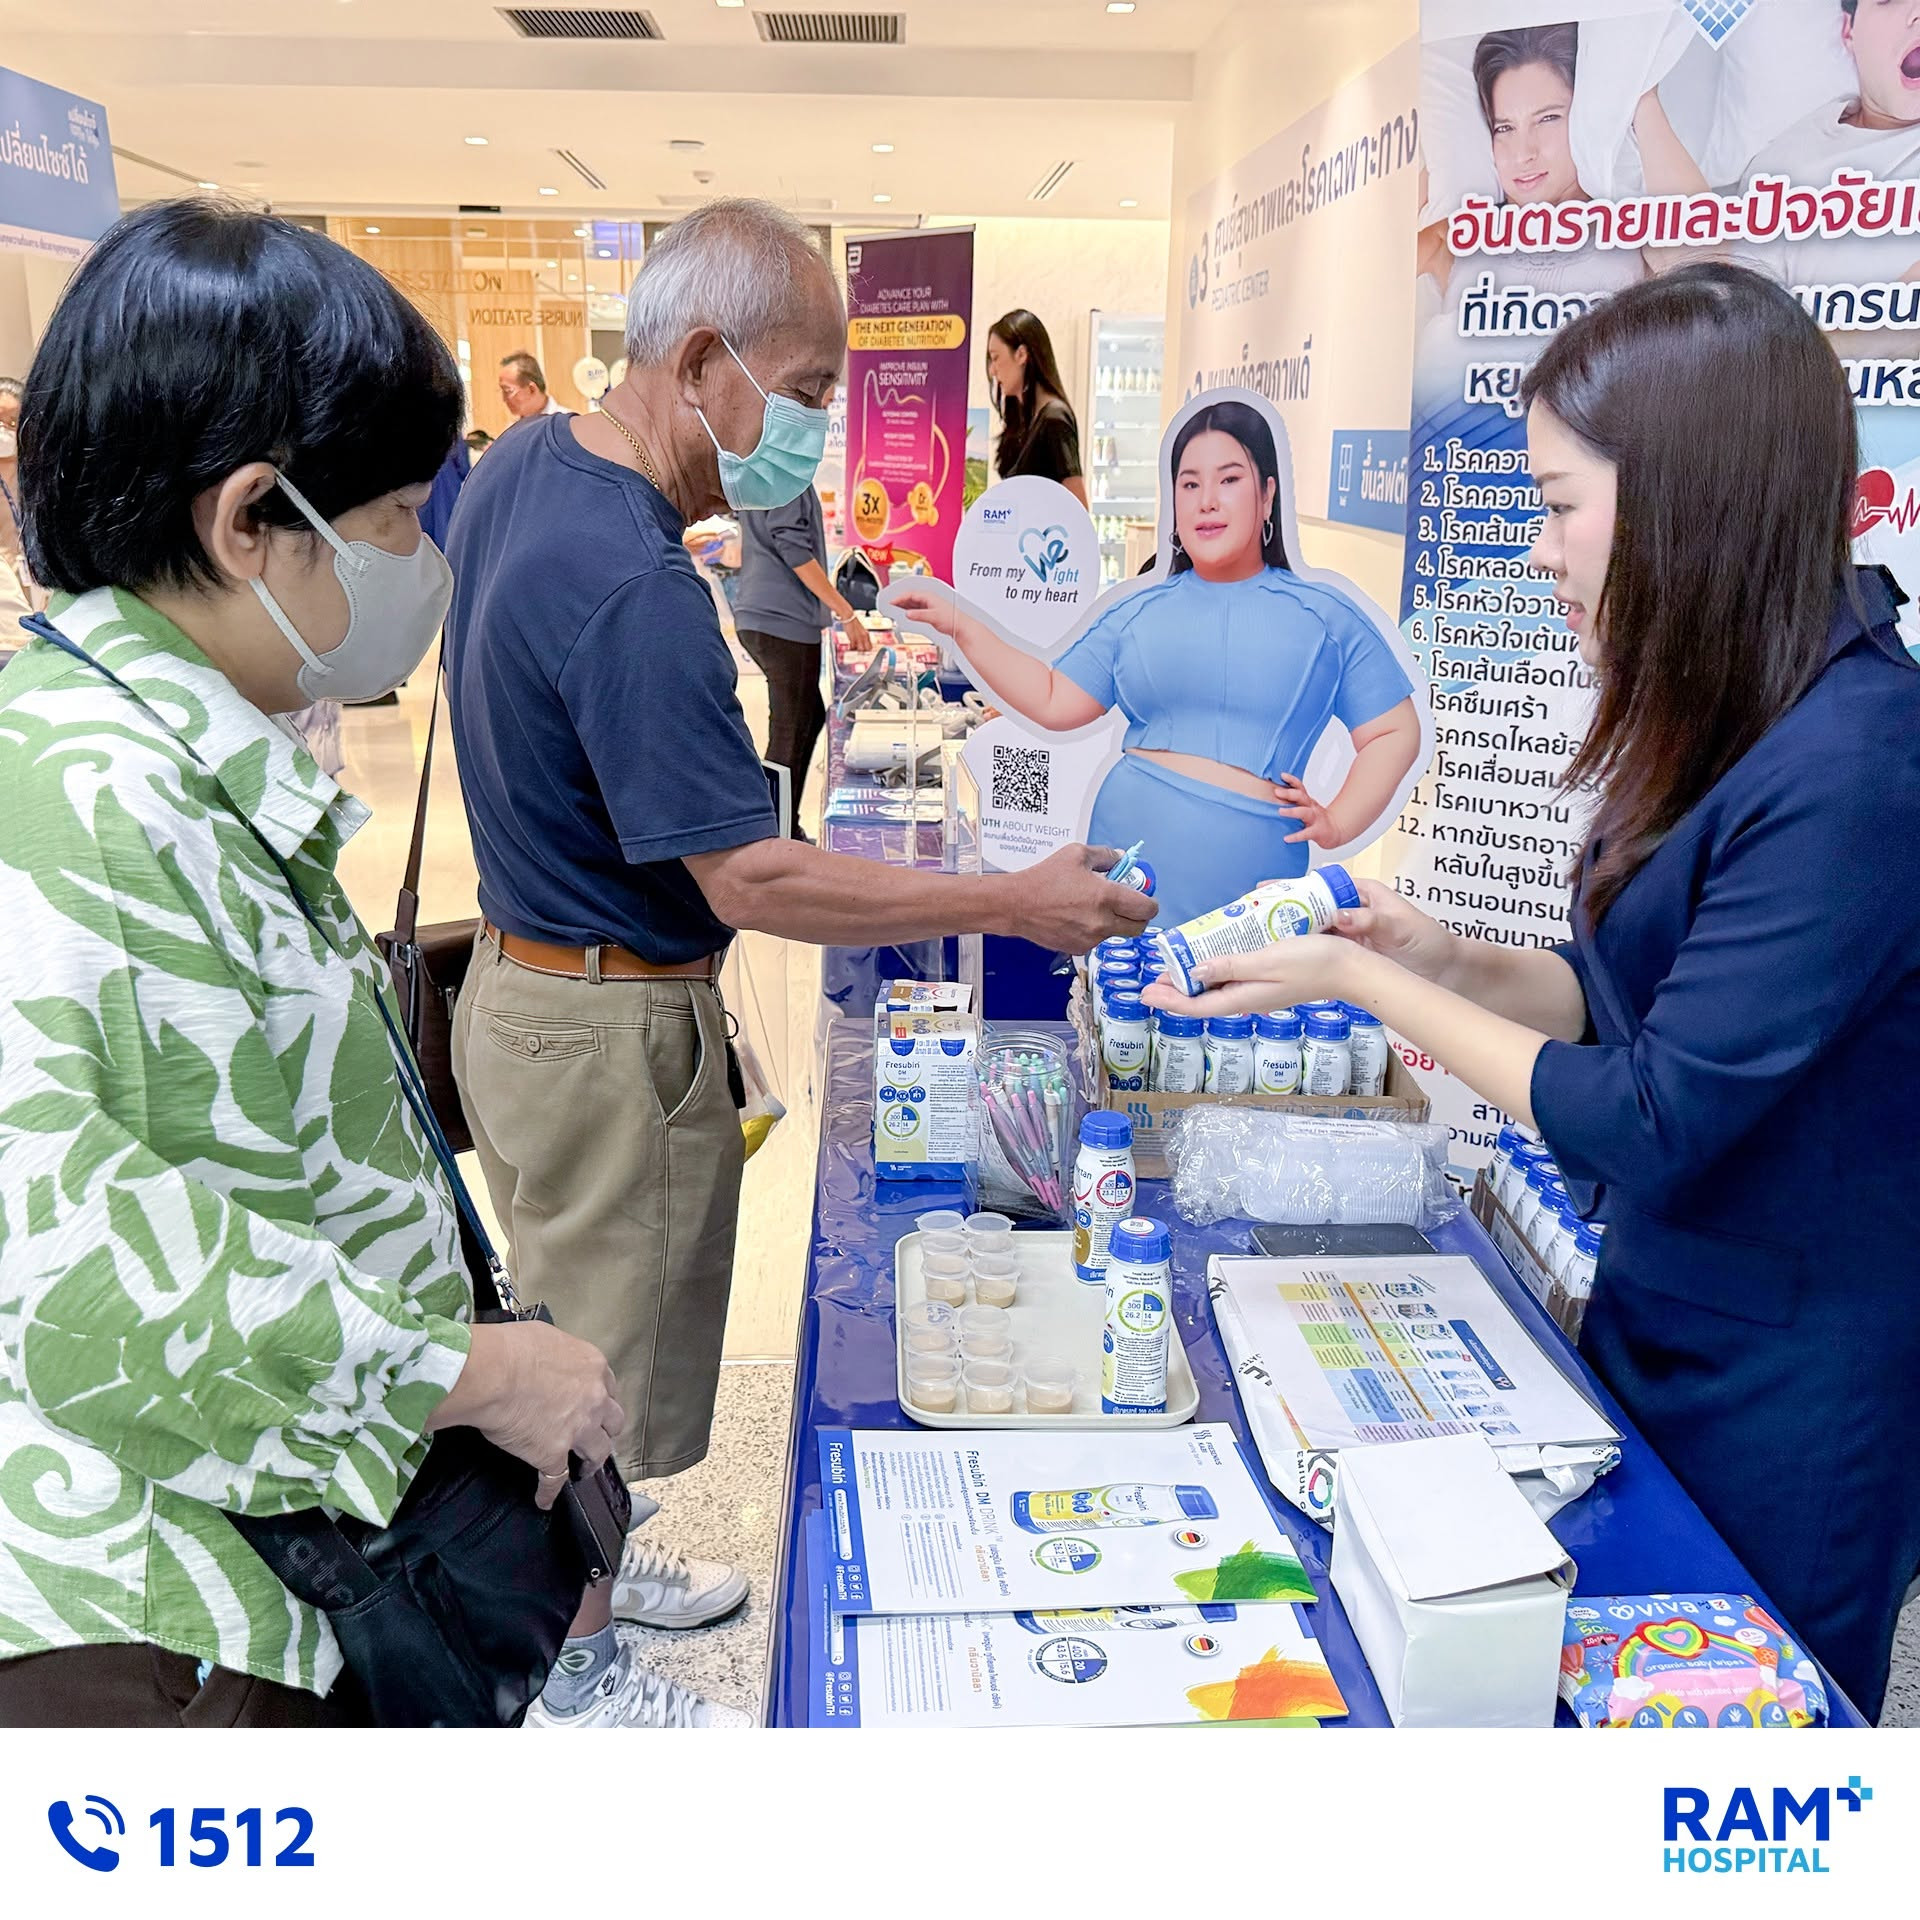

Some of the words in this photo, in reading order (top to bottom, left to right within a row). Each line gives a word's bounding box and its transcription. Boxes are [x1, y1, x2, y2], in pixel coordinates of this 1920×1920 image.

[0, 120, 89, 184] ปลี่ยนไซซ์ได้
[1452, 175, 1920, 250] อันตรายและปัจจัยเ
[1463, 278, 1600, 331] ที่เกิดจ
[855, 322, 871, 334] THE
[873, 321, 896, 334] NEXT
[897, 319, 952, 333] GENERATION
[858, 336, 869, 347] OF
[870, 335, 905, 347] DIABETES
[906, 334, 947, 346] NUTRITION
[1424, 448, 1442, 471] 1.
[1448, 441, 1529, 472] โรคควา
[1421, 483, 1440, 506] 2.
[1445, 477, 1543, 509] โรคความ
[984, 509, 1007, 520] RAM
[1418, 518, 1436, 542] 3.
[970, 562, 1002, 578] From
[1006, 568, 1026, 583] my
[1415, 553, 1434, 576] 4.
[1005, 586, 1018, 600] to
[1022, 588, 1041, 604] my
[1045, 587, 1079, 604] heart
[1414, 588, 1430, 609] 5.
[1412, 621, 1428, 643] 6.
[1435, 725, 1582, 758] รคกรดไหลย้อ
[1410, 786, 1428, 807] 1.
[1434, 783, 1570, 824] โรคเบาหวาน
[1002, 820, 1033, 833] ABOUT
[1034, 824, 1071, 838] WEIGHT
[1397, 815, 1426, 838] 12.
[1433, 853, 1568, 890] หลับในสูงขึ้น
[1393, 876, 1421, 899] 13.
[1427, 885, 1571, 923] การนอนกรน
[1109, 1038, 1145, 1050] Fresubin
[885, 1061, 920, 1069] Fresubin
[1262, 1059, 1298, 1070] Fresubin
[829, 1442, 847, 1485] Fresubin
[966, 1450, 988, 1488] Fresubin
[1297, 1450, 1306, 1494] EMIUM
[976, 1492, 992, 1505] DM
[1074, 1661, 1086, 1671] 20
[601, 1671, 616, 1694] NIKE
